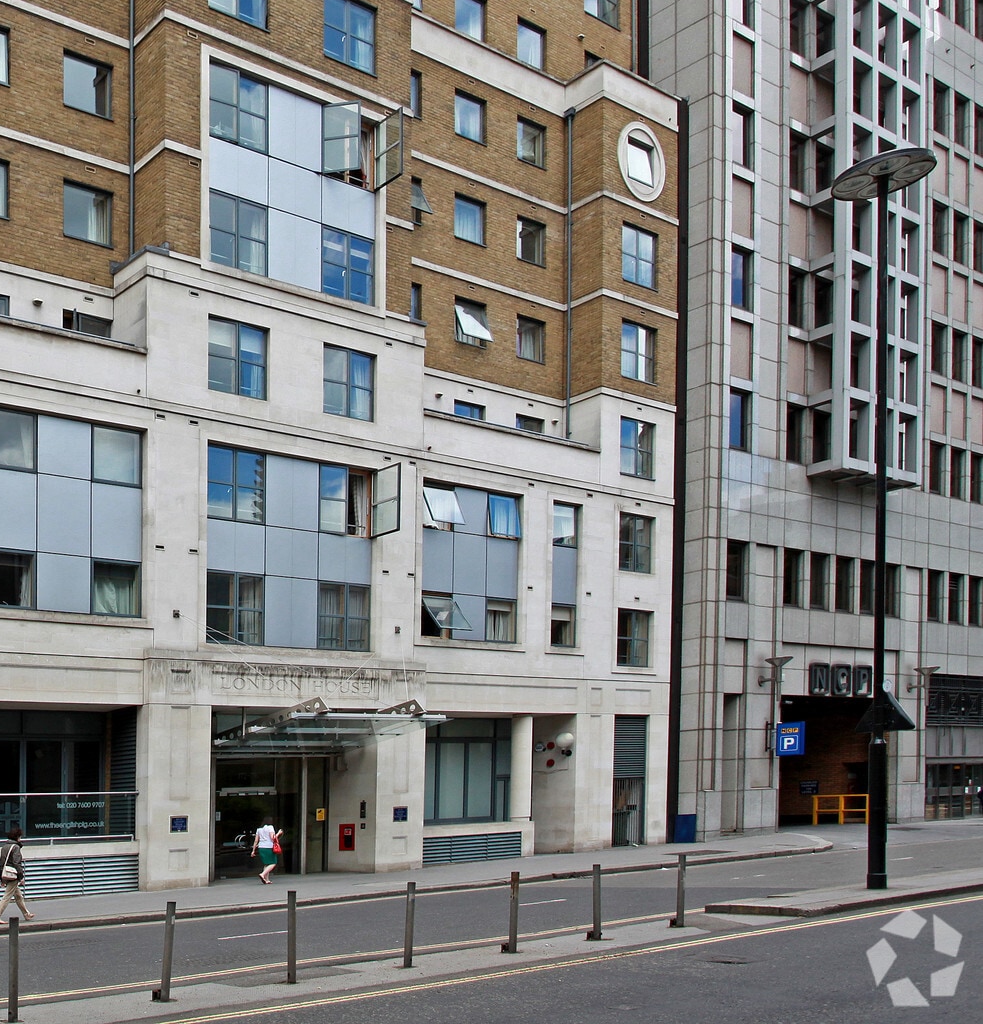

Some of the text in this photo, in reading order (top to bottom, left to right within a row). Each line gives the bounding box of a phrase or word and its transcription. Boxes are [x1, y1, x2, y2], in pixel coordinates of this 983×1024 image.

[220, 676, 371, 694] LONDON HOUSE
[810, 664, 872, 694] NCP
[784, 738, 794, 750] P
